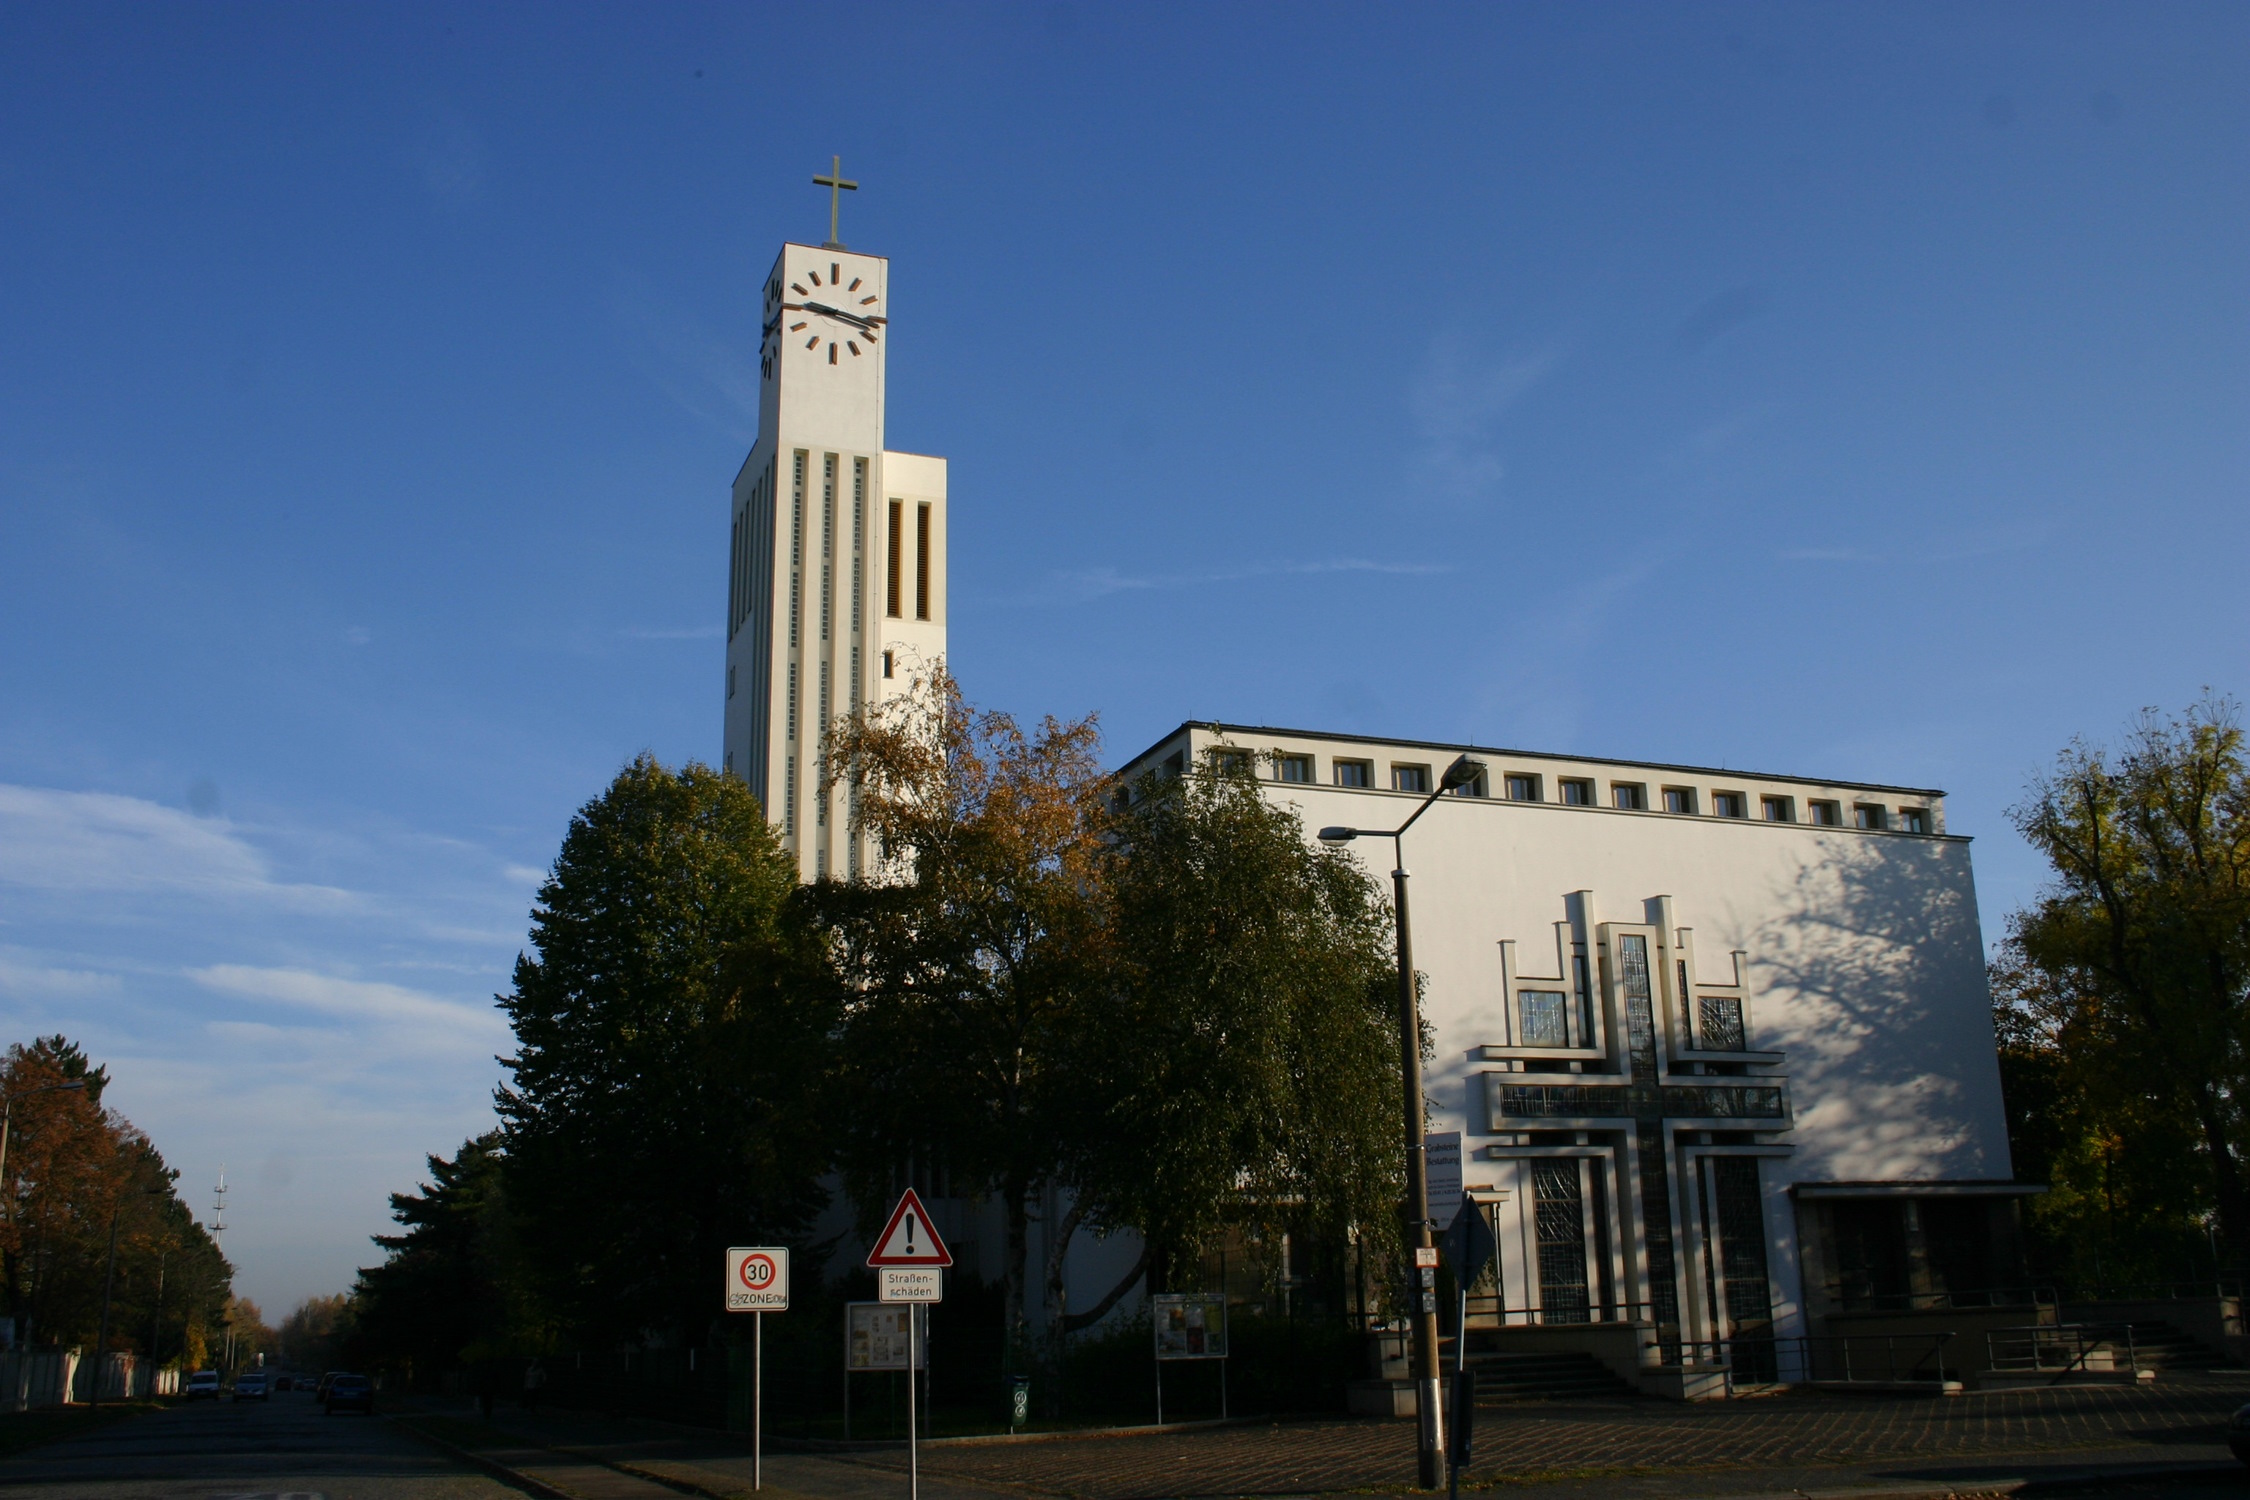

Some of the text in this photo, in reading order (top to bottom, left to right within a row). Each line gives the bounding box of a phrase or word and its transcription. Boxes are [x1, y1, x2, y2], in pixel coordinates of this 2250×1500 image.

[1426, 1143, 1459, 1154] Grabsteine
[1426, 1156, 1460, 1166] Bestattung
[747, 1264, 768, 1281] 30
[888, 1273, 933, 1283] Straßen-
[890, 1286, 932, 1296] schäden
[743, 1293, 773, 1304] ZONE
